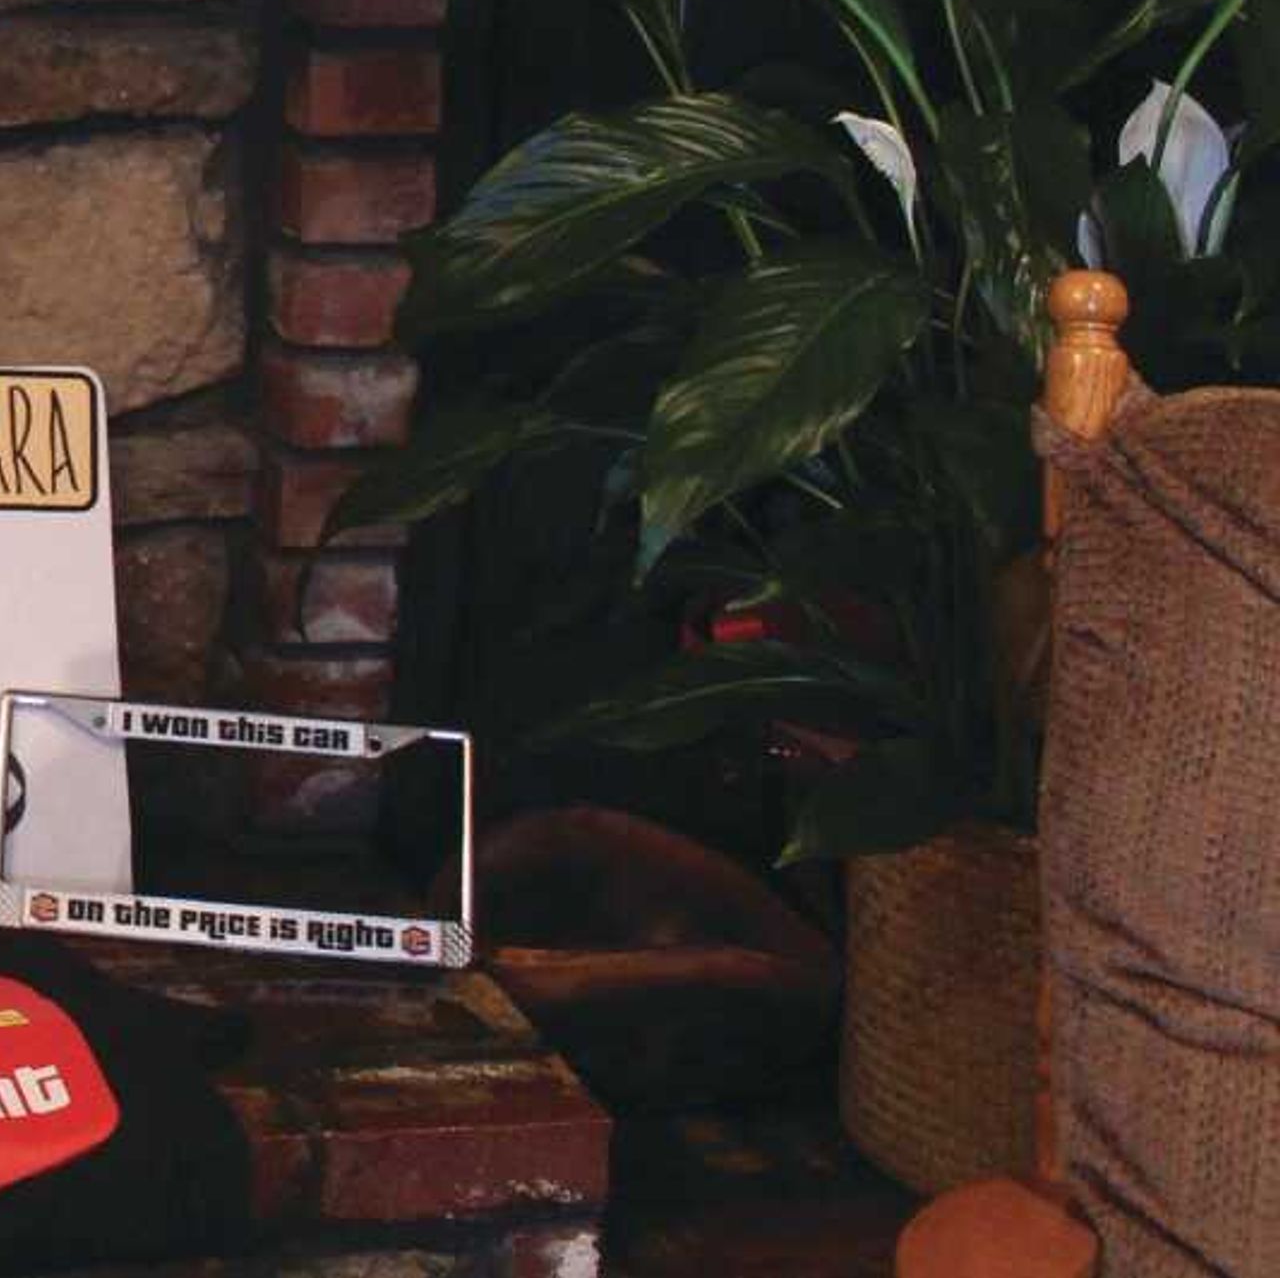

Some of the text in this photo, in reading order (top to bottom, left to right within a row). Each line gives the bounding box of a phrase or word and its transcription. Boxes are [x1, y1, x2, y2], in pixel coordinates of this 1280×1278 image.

[122, 710, 132, 733] I
[217, 715, 286, 746] this
[67, 898, 104, 923] on
[114, 900, 171, 930] the
[307, 919, 395, 952] Right
